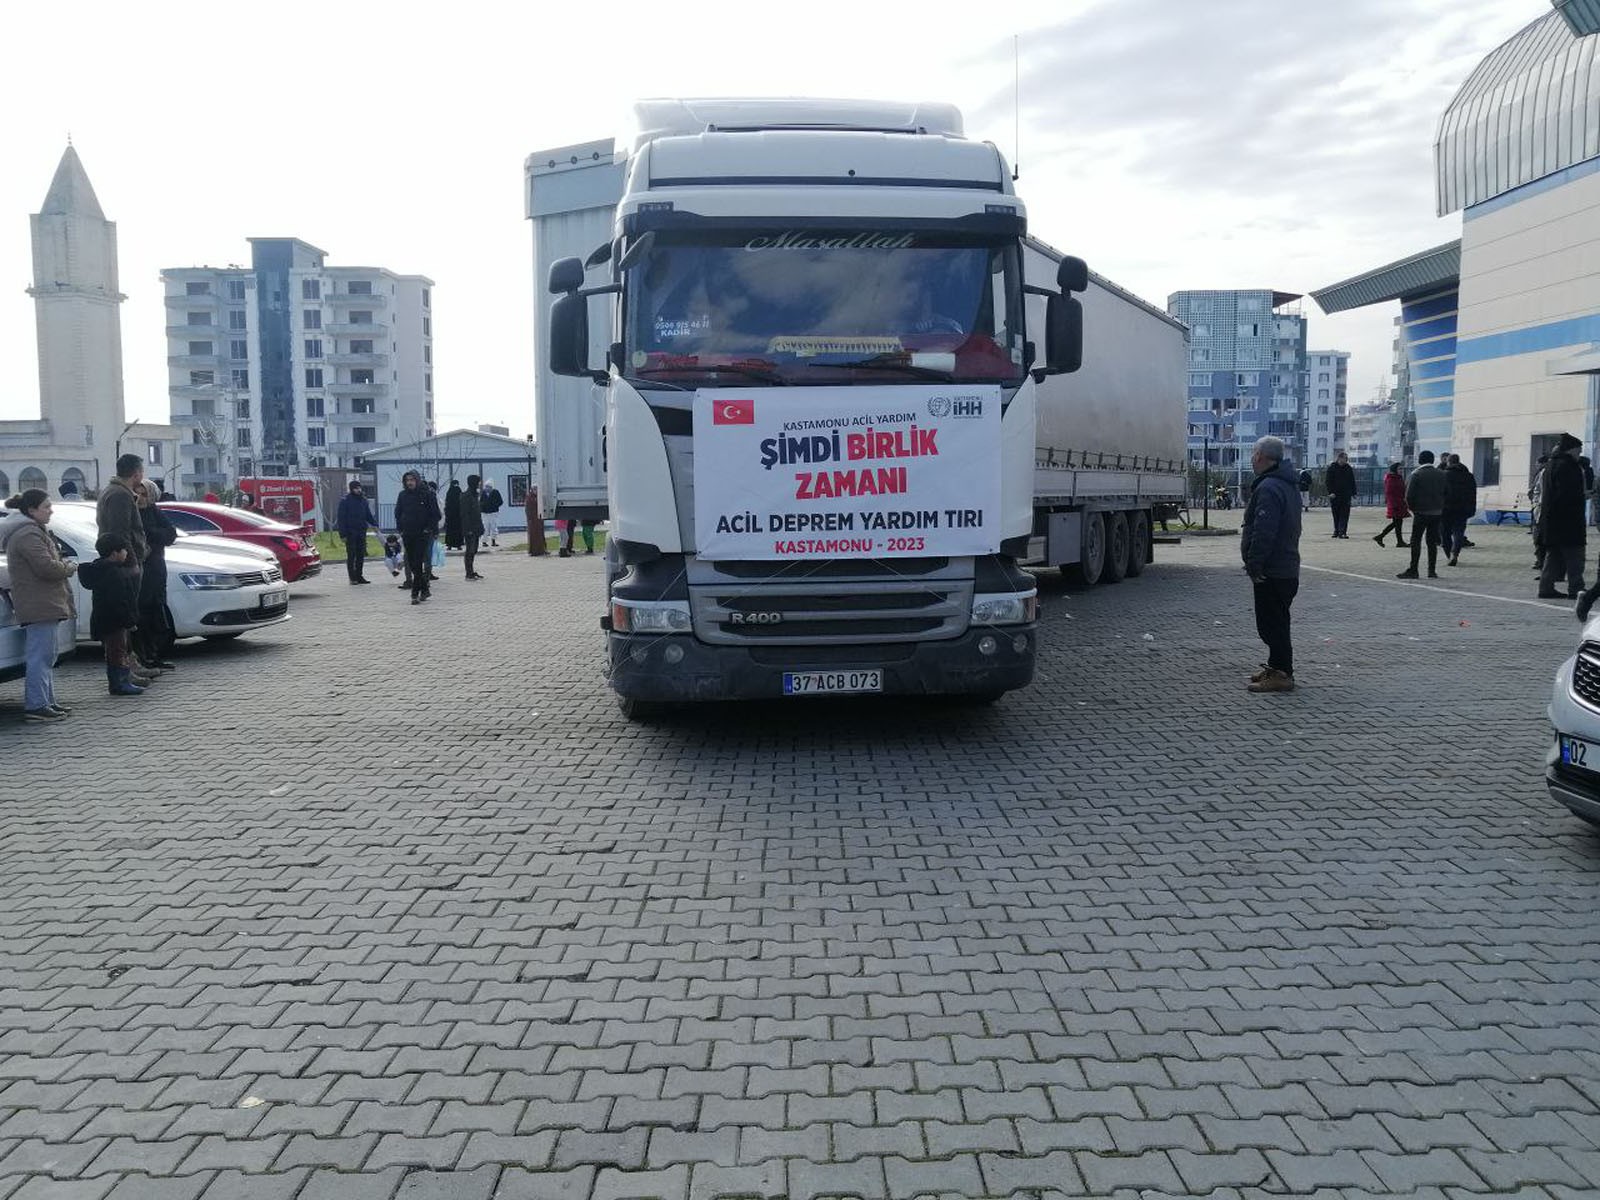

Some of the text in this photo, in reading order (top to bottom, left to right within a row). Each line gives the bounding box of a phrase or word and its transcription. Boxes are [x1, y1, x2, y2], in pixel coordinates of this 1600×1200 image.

[783, 412, 917, 431] KASTAMONU ACİL YARDIM
[760, 424, 939, 470] ŞİMDİ BİRLİK
[795, 467, 908, 500] ZAMANI
[716, 509, 983, 534] ACİL DEPREM YARDIM TIRI
[775, 539, 873, 555] KASTAMONU
[887, 537, 925, 552] 2023
[731, 613, 781, 624] R 400
[793, 672, 878, 691] 37 ACB 073
[1570, 740, 1588, 766] 02
